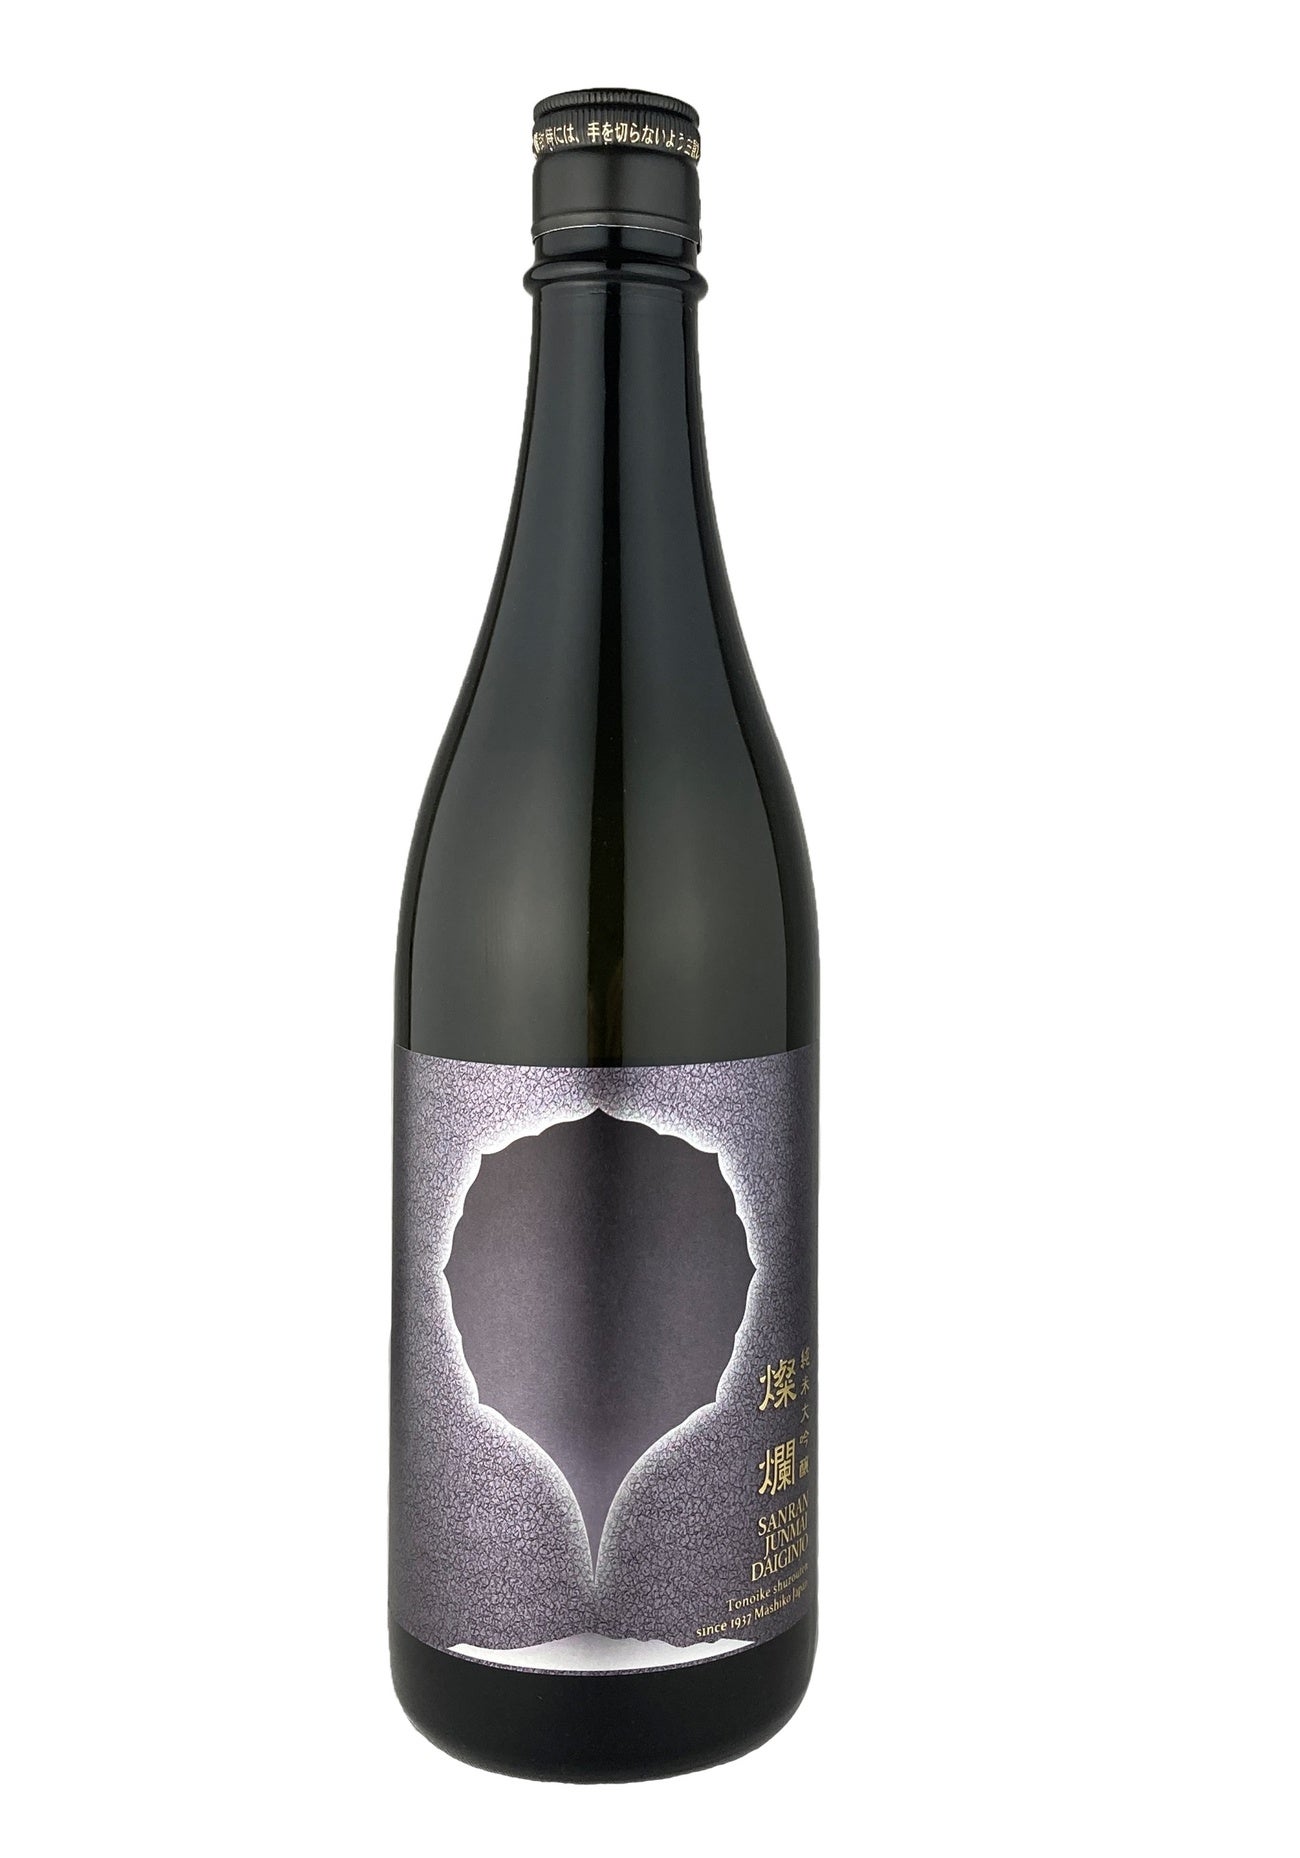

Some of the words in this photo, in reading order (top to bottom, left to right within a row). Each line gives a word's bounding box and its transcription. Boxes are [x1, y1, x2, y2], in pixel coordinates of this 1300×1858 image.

[758, 1358, 798, 1495] 燦爛
[757, 1490, 809, 1537] SANRAN
[763, 1511, 808, 1560] JUNMAI
[750, 1531, 809, 1582] DAIGINJO
[695, 1621, 728, 1638] since
[730, 1613, 753, 1630] 1937
[754, 1593, 792, 1619] Mashiko
[725, 1587, 771, 1612] Tonoike
